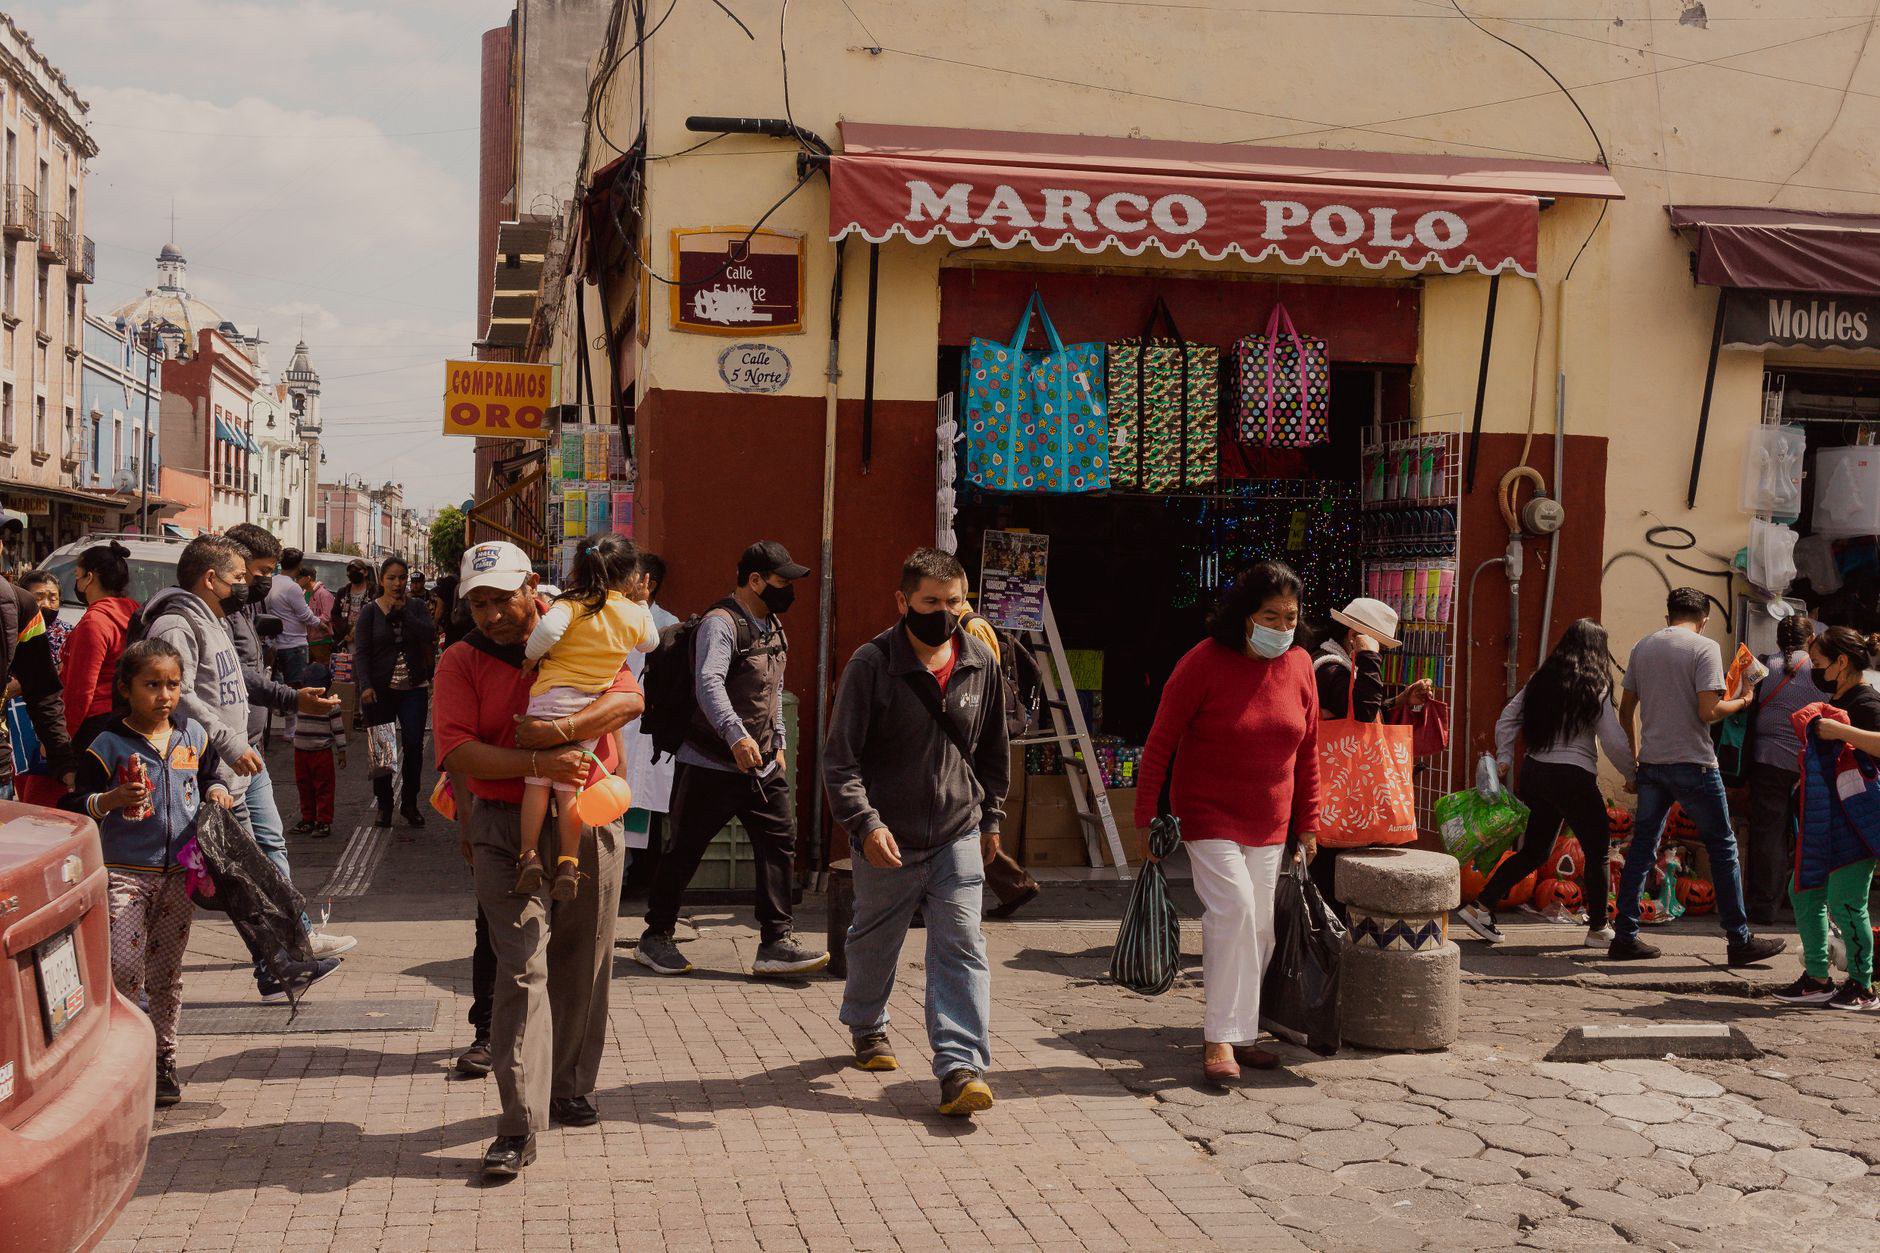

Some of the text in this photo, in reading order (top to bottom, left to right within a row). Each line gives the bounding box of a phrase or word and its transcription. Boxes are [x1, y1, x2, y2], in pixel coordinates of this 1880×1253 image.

[905, 179, 1469, 250] MARCO POLO
[726, 265, 753, 280] Calle
[1768, 299, 1868, 341] Moldes
[741, 351, 770, 366] Calle
[452, 369, 546, 398] COMPRAMOS
[731, 368, 783, 385] 5 Norte
[450, 402, 545, 429] ORO
